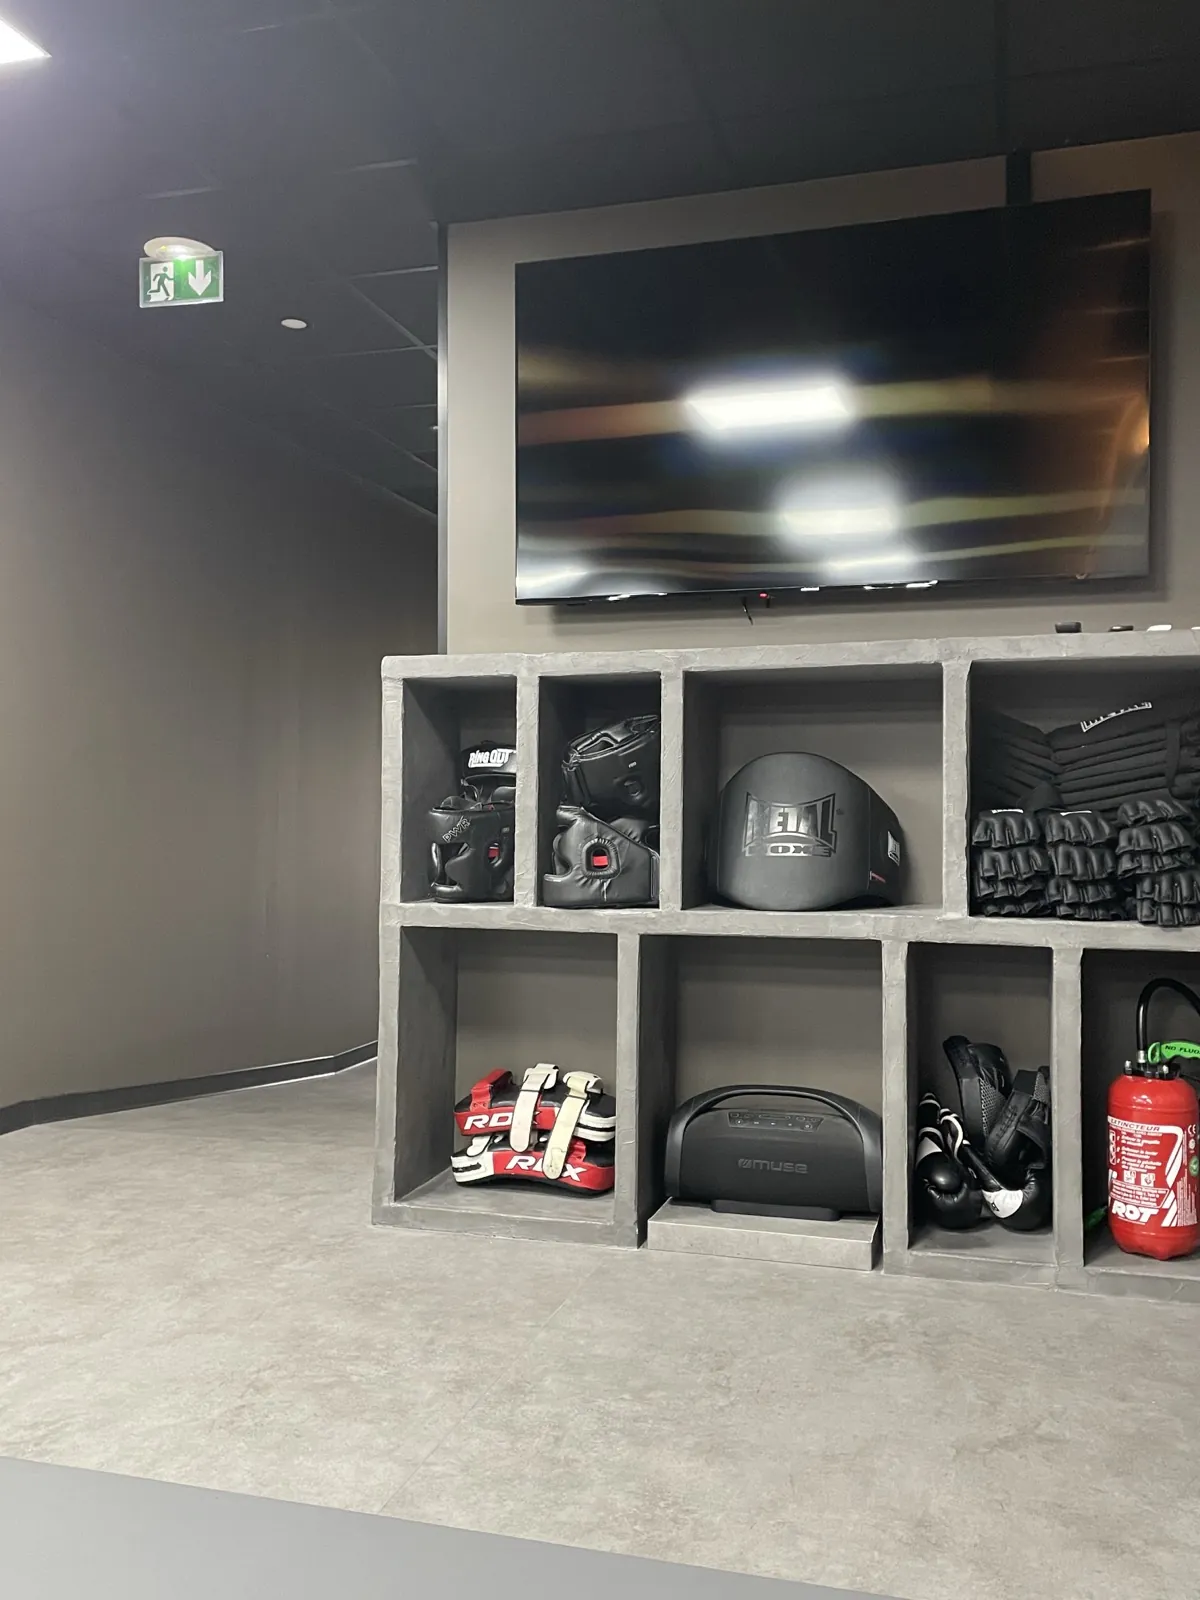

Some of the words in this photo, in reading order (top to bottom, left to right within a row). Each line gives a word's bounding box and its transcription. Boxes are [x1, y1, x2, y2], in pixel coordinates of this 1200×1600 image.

[468, 750, 489, 768] RING
[490, 748, 513, 764] OUT
[442, 815, 471, 843] PWR
[742, 792, 837, 853] METAL
[1112, 1199, 1159, 1223] ROT
